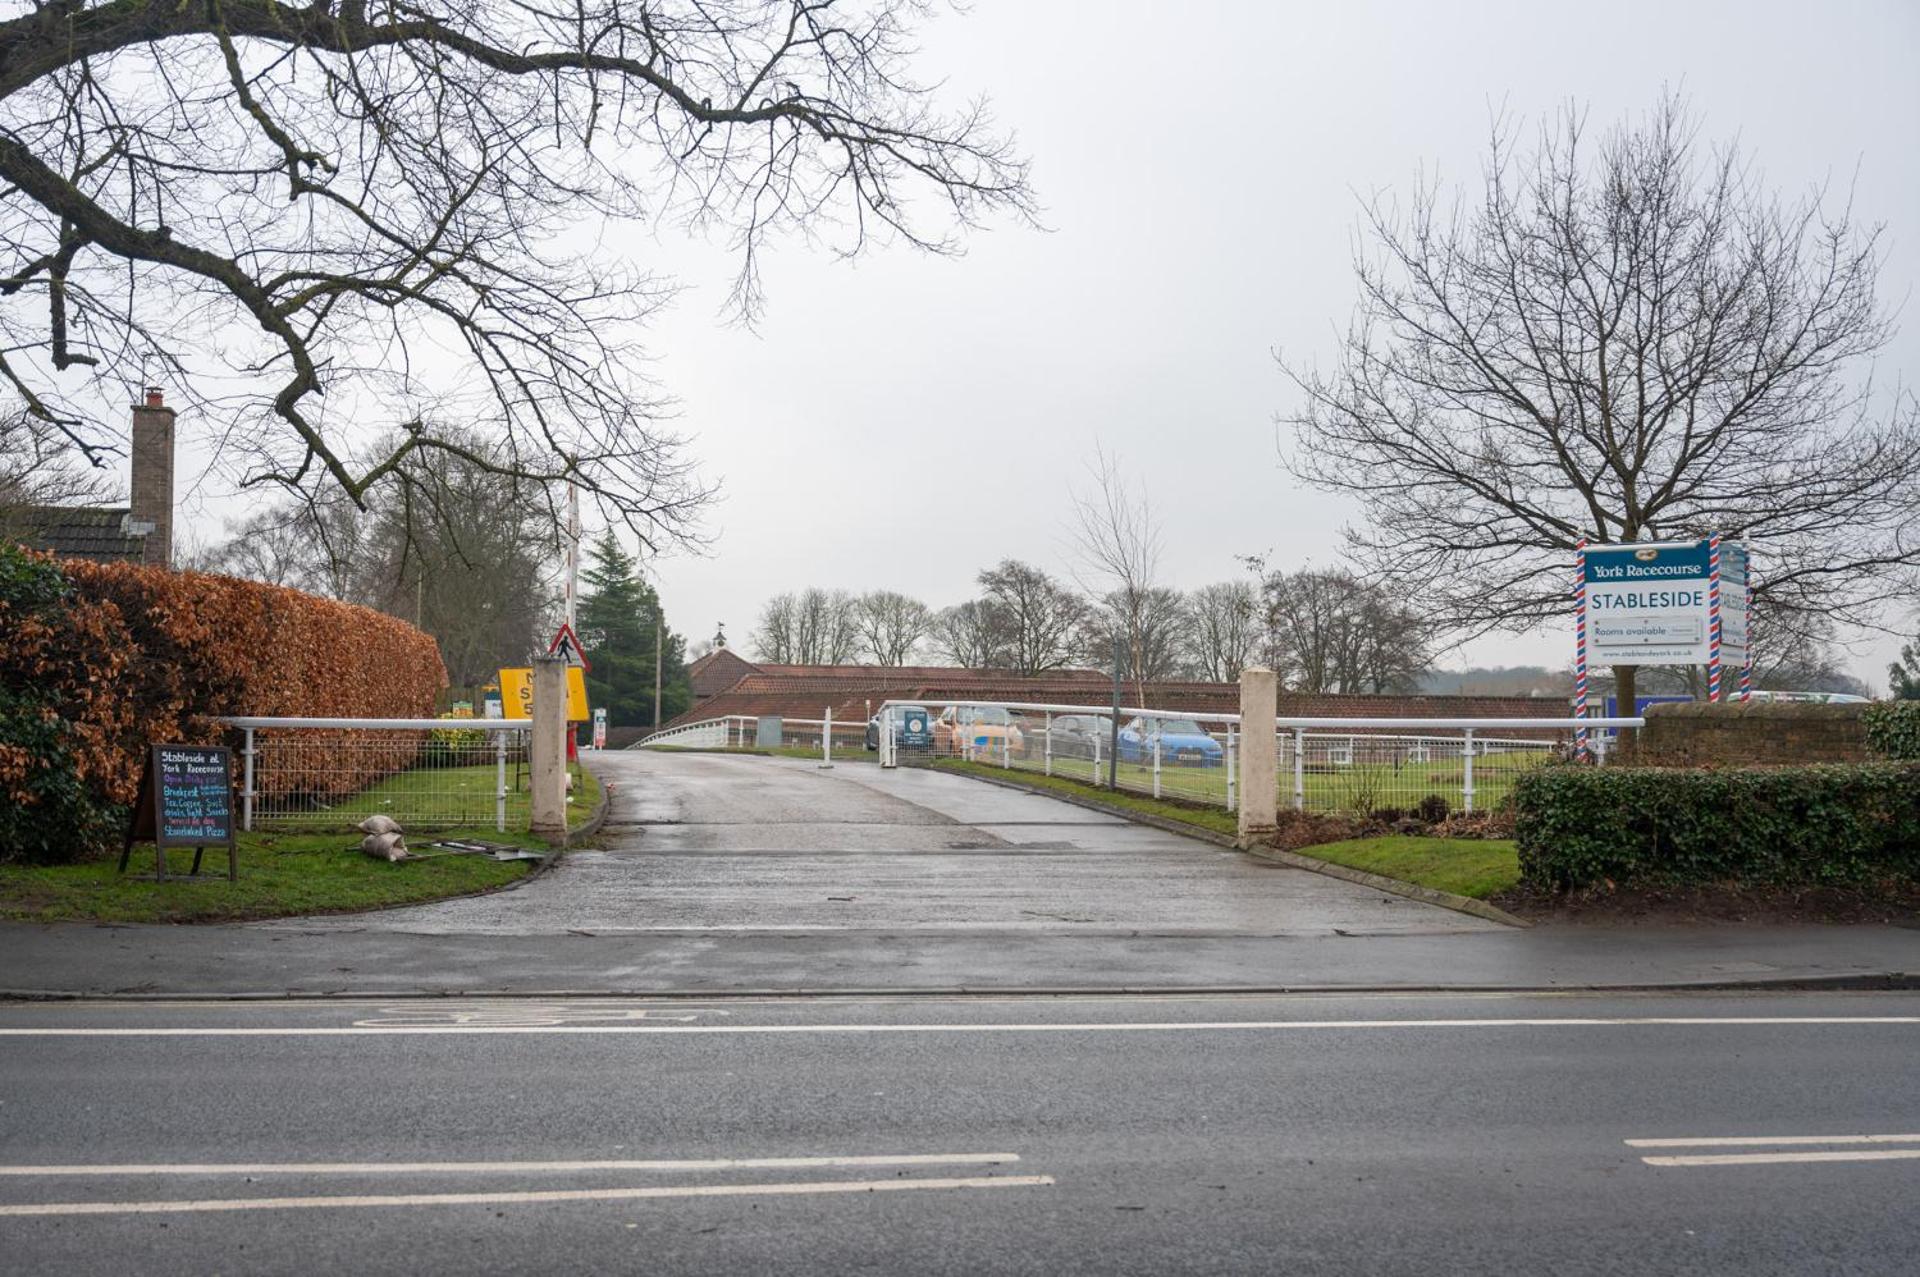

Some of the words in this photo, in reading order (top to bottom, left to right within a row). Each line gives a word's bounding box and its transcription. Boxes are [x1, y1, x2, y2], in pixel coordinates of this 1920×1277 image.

[1593, 565, 1624, 578] York
[1626, 563, 1702, 577] Racecourse
[1591, 591, 1703, 610] STABLESIDE
[1595, 627, 1624, 636] Rooms
[1626, 626, 1666, 636] available
[161, 752, 205, 763] Stableside
[209, 753, 220, 763] at
[162, 763, 180, 773] York
[187, 763, 224, 773] Racecourse
